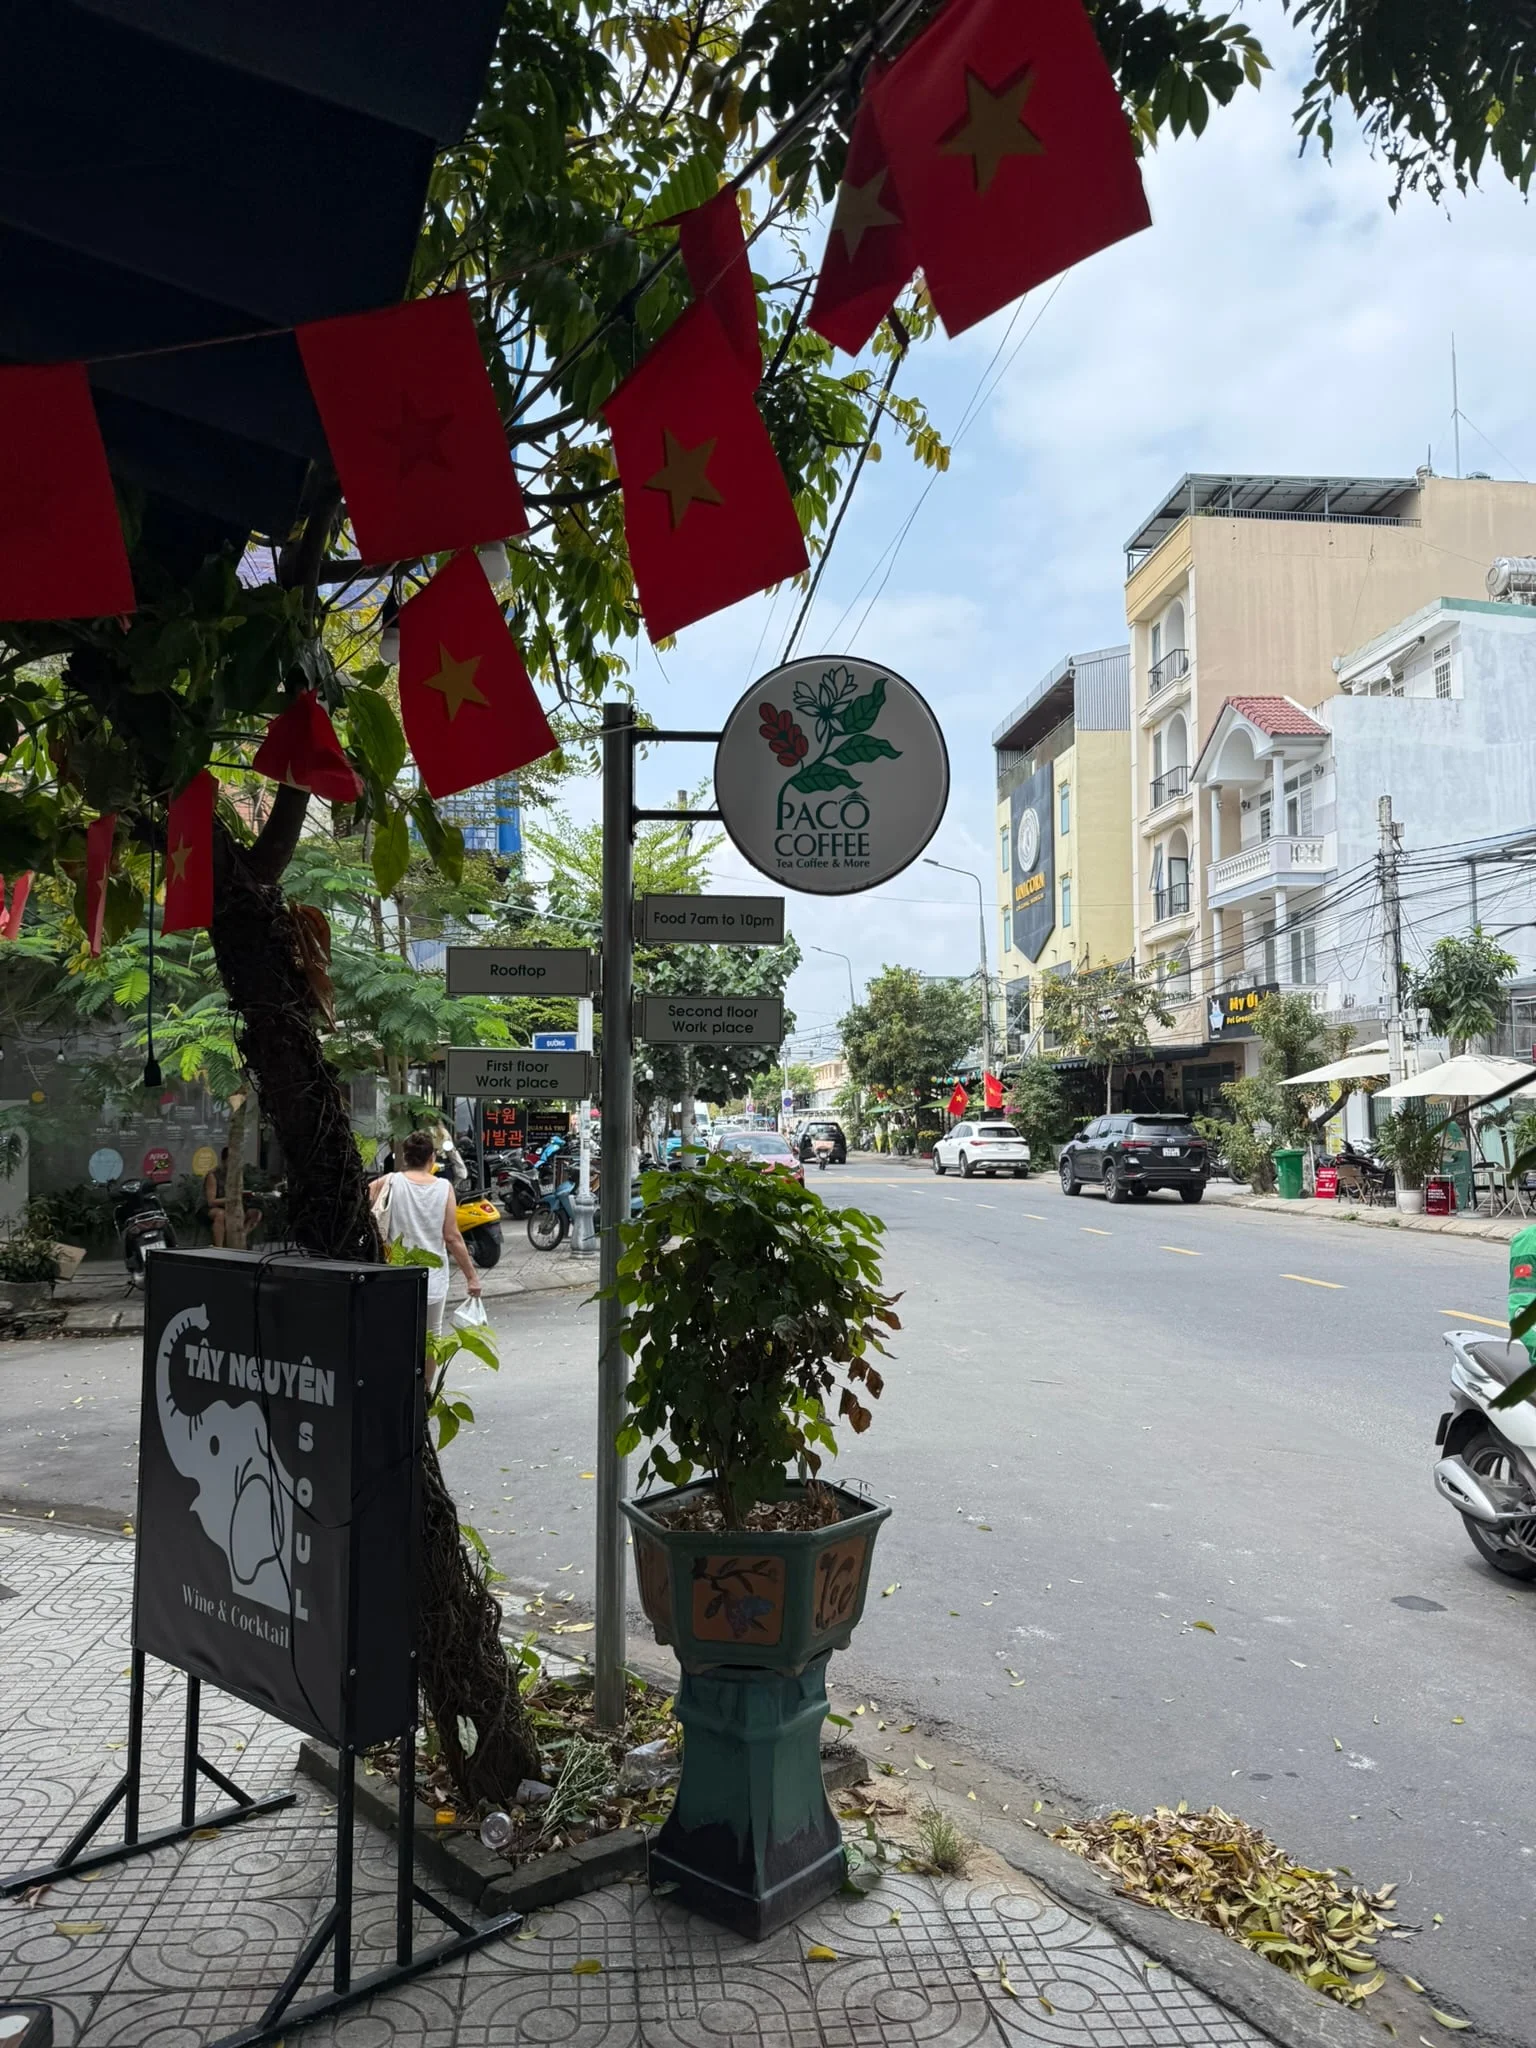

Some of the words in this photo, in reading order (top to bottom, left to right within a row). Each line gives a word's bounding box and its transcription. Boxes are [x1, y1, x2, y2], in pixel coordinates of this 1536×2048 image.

[774, 833, 870, 857] COFFEE
[776, 859, 793, 868] Tea
[796, 858, 829, 868] Coffee
[832, 859, 840, 868] &
[843, 859, 870, 868] More
[654, 912, 686, 925] Food
[690, 913, 718, 925] 7am
[722, 914, 735, 926] to
[740, 914, 774, 928] 10pm
[490, 964, 546, 979] Rooftop
[668, 1005, 723, 1018] Second
[727, 1006, 759, 1018] floor
[672, 1020, 707, 1033] Work
[712, 1022, 754, 1035] place
[486, 1060, 513, 1072] First
[517, 1060, 549, 1072] floor
[475, 1075, 511, 1088] Work
[516, 1076, 559, 1090] place
[185, 1338, 225, 1384] TÂY
[229, 1353, 335, 1407] NGUYÊN
[295, 1421, 314, 1622] SOUL
[182, 1584, 215, 1618] Wine
[217, 1600, 228, 1623] &
[231, 1606, 289, 1650] Cocktail
